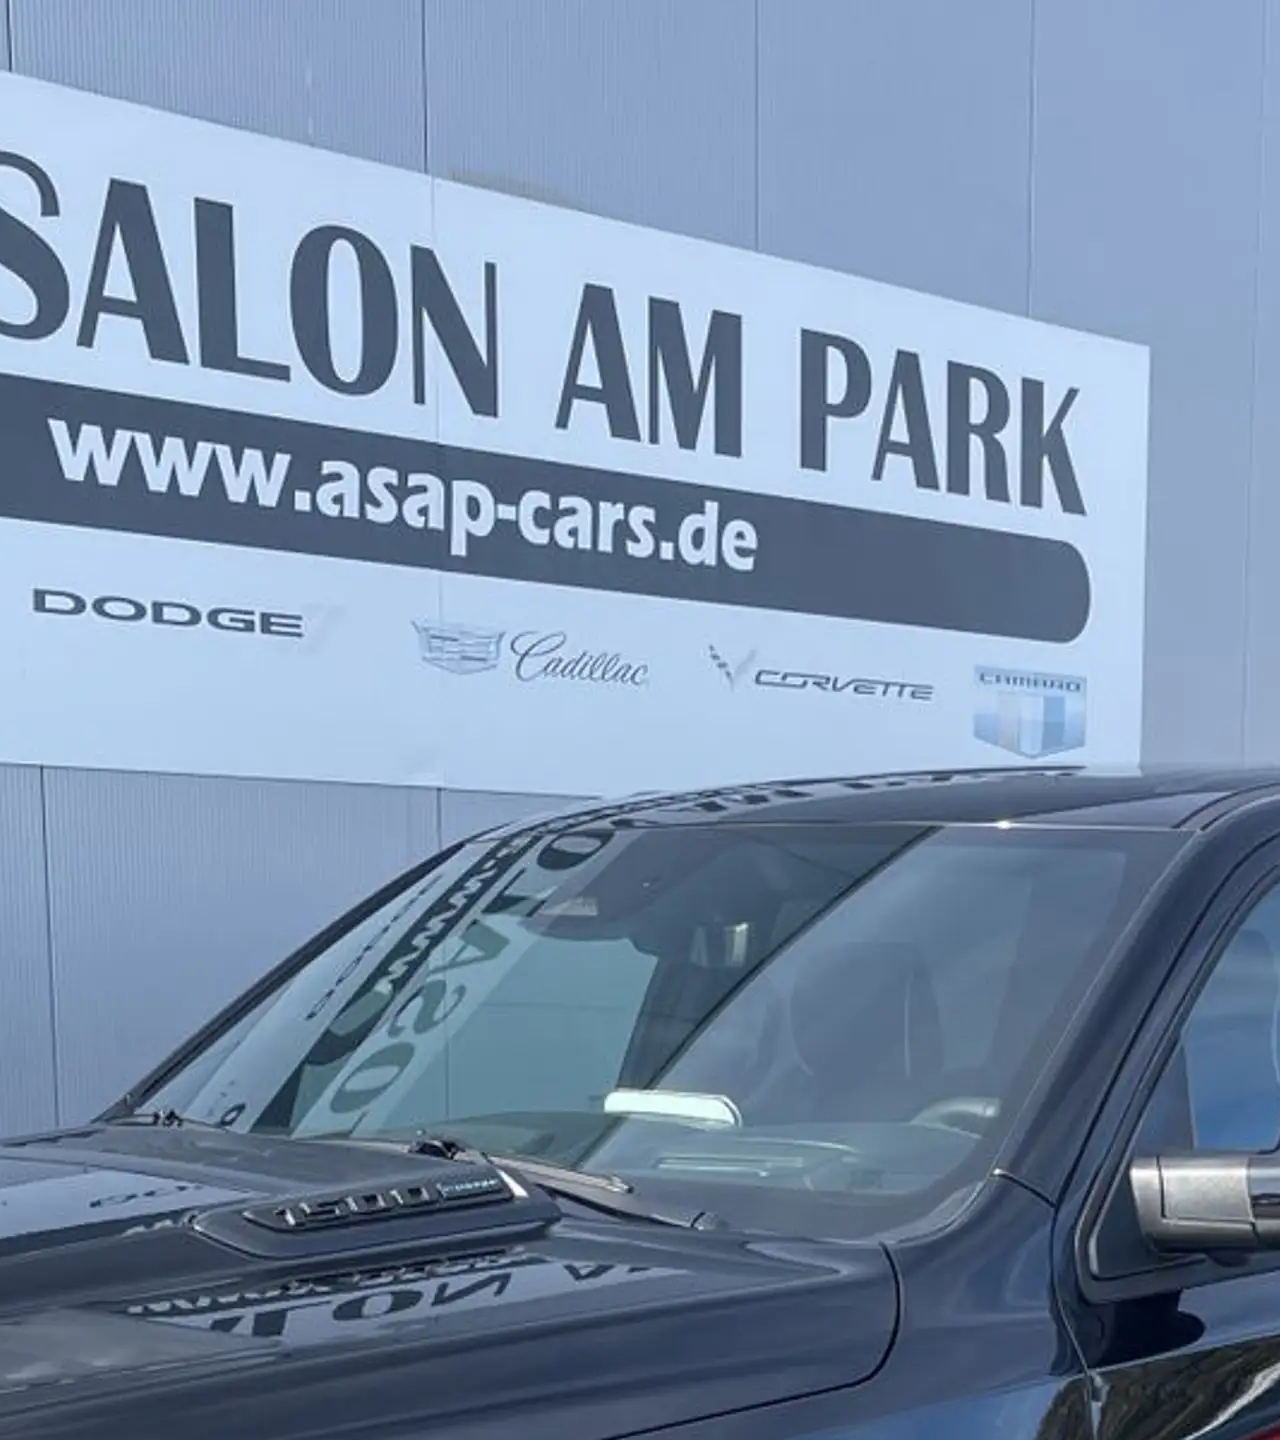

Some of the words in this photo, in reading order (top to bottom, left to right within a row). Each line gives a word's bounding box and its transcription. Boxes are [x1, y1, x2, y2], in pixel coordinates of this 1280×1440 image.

[554, 282, 743, 459] AM
[798, 328, 1087, 517] PARK
[47, 417, 759, 572] www.asap-cars.de
[32, 587, 304, 638] DODGE
[509, 630, 649, 687] Cadillac
[754, 669, 934, 700] CORVETTE
